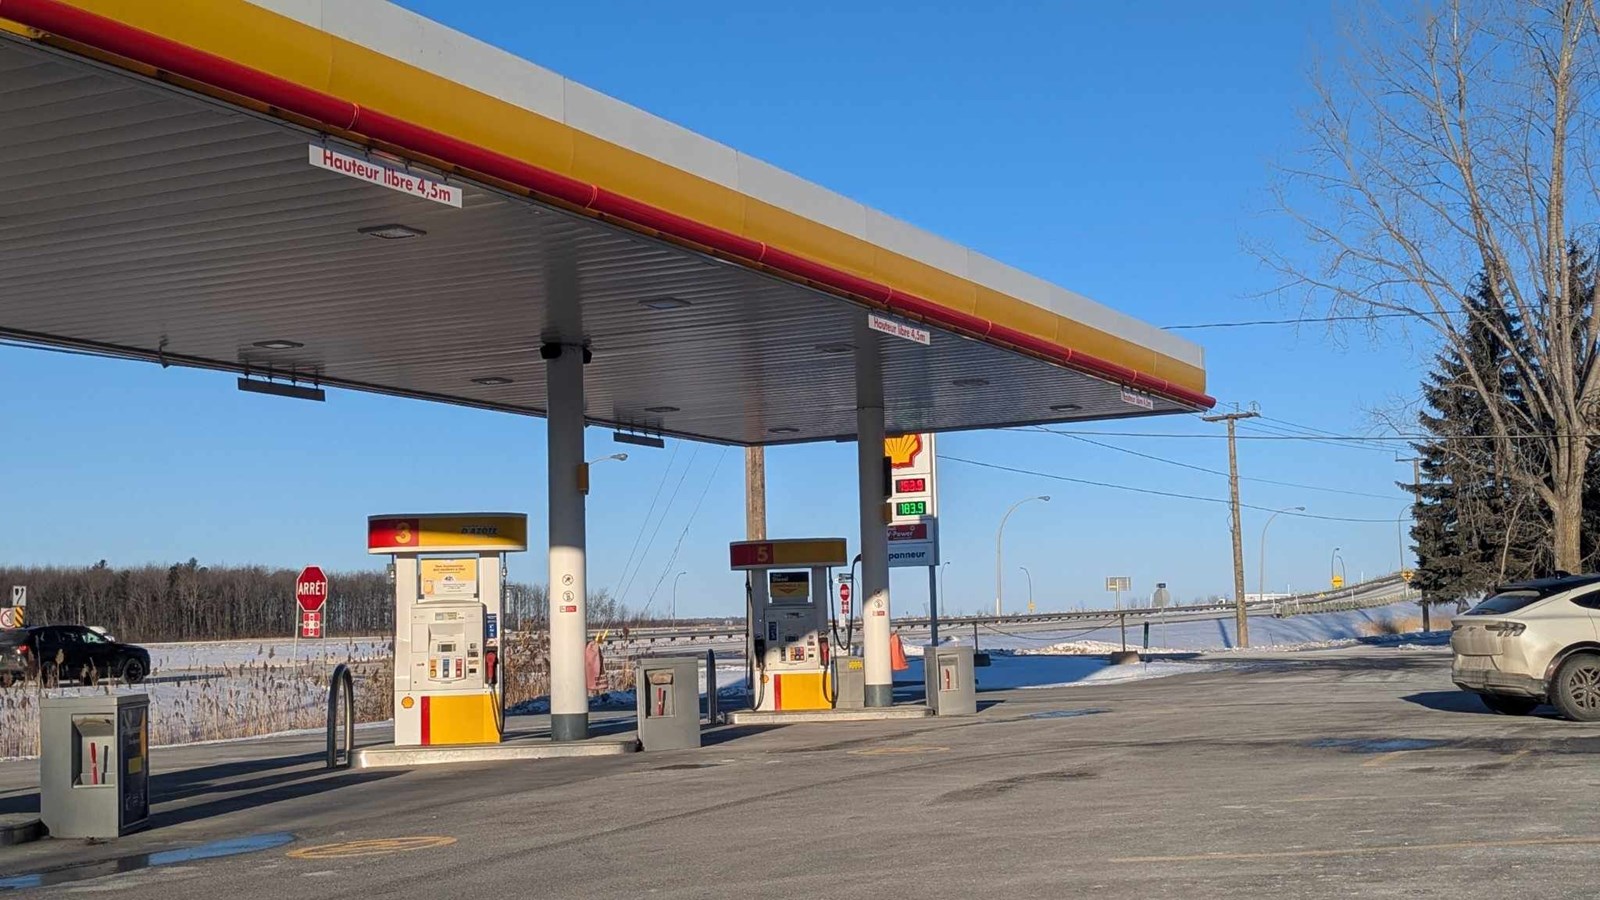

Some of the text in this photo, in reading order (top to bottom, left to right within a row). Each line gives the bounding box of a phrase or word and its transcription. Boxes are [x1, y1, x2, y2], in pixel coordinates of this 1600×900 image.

[323, 149, 451, 202] Hauteur libre 4,5m
[901, 502, 924, 514] 183.9
[395, 522, 412, 544] 3
[757, 546, 769, 562] 5
[298, 580, 326, 596] ARRÊT
